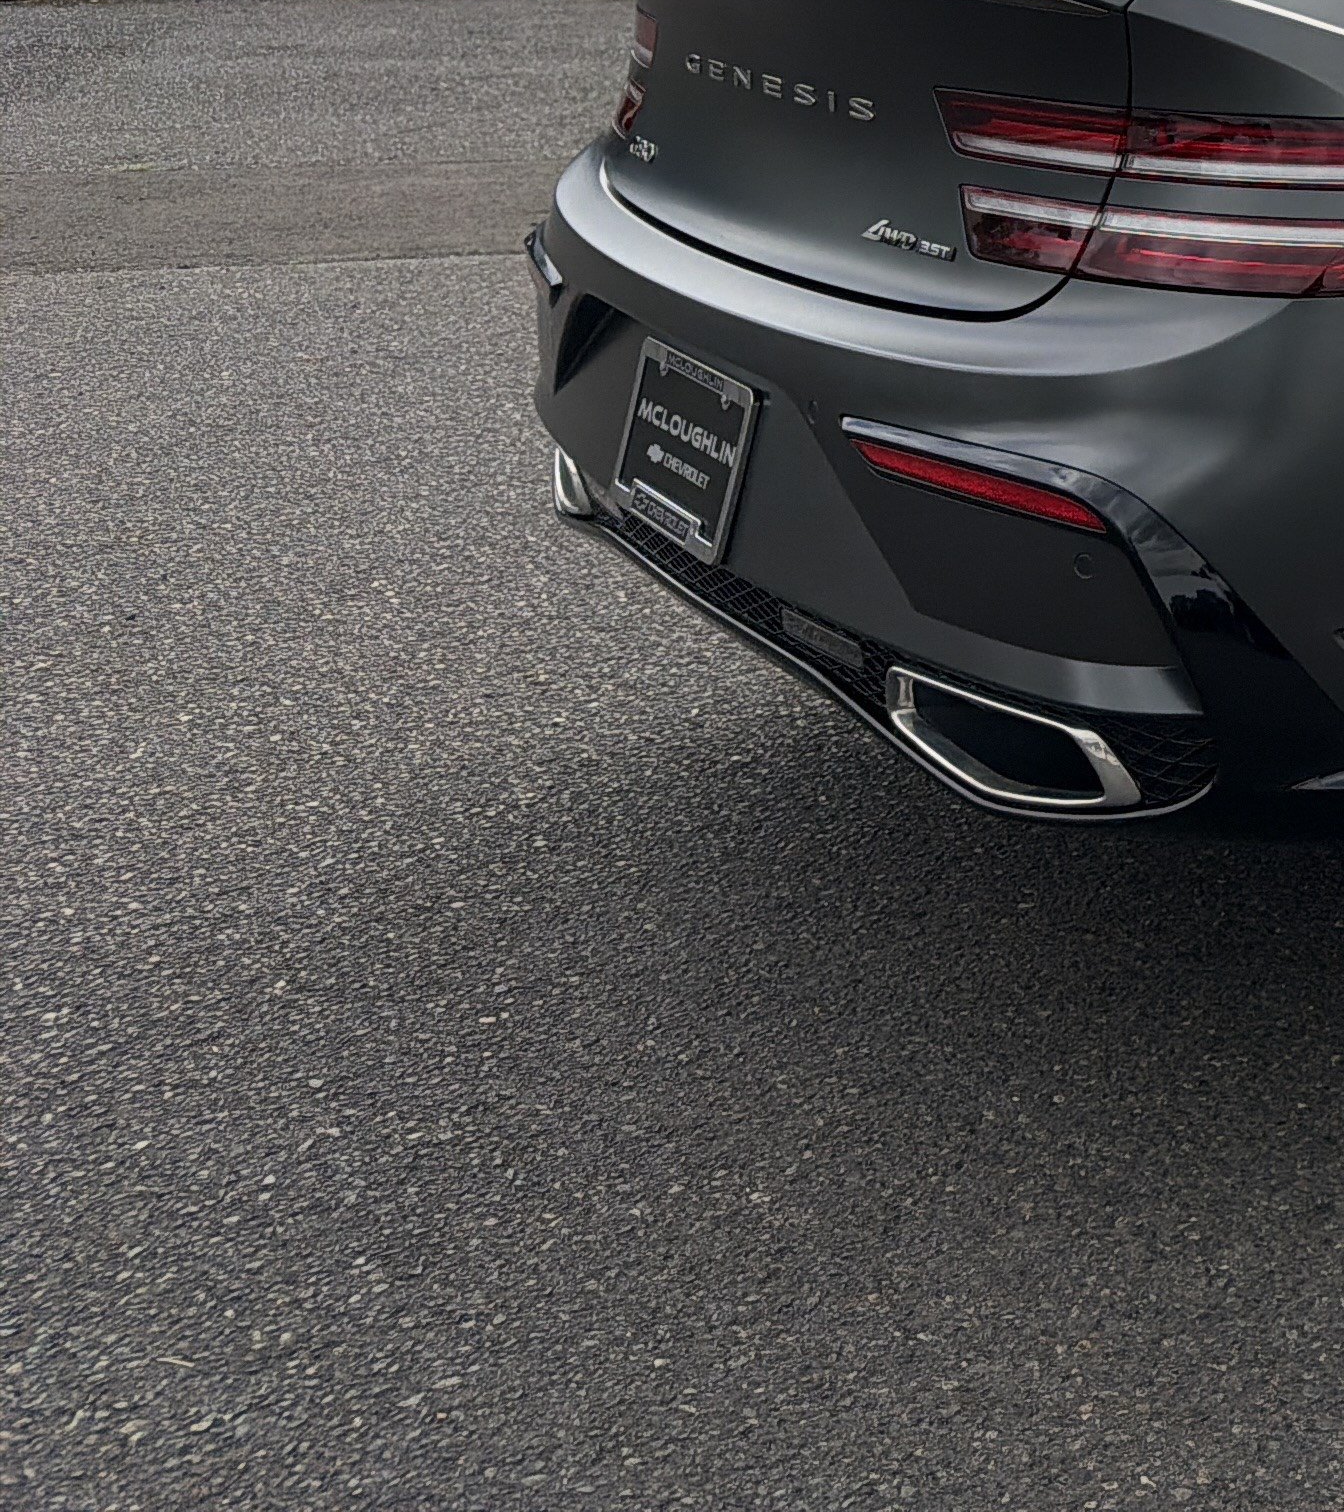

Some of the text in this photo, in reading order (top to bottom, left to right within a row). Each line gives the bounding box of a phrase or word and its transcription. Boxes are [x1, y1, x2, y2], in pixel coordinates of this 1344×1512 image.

[685, 52, 877, 121] GENESIS
[666, 349, 725, 392] MCLOUGHLIN
[636, 397, 737, 468] MCLOUGHLIN
[662, 452, 711, 490] CHEVROLET
[646, 500, 691, 538] CHEVROLET
